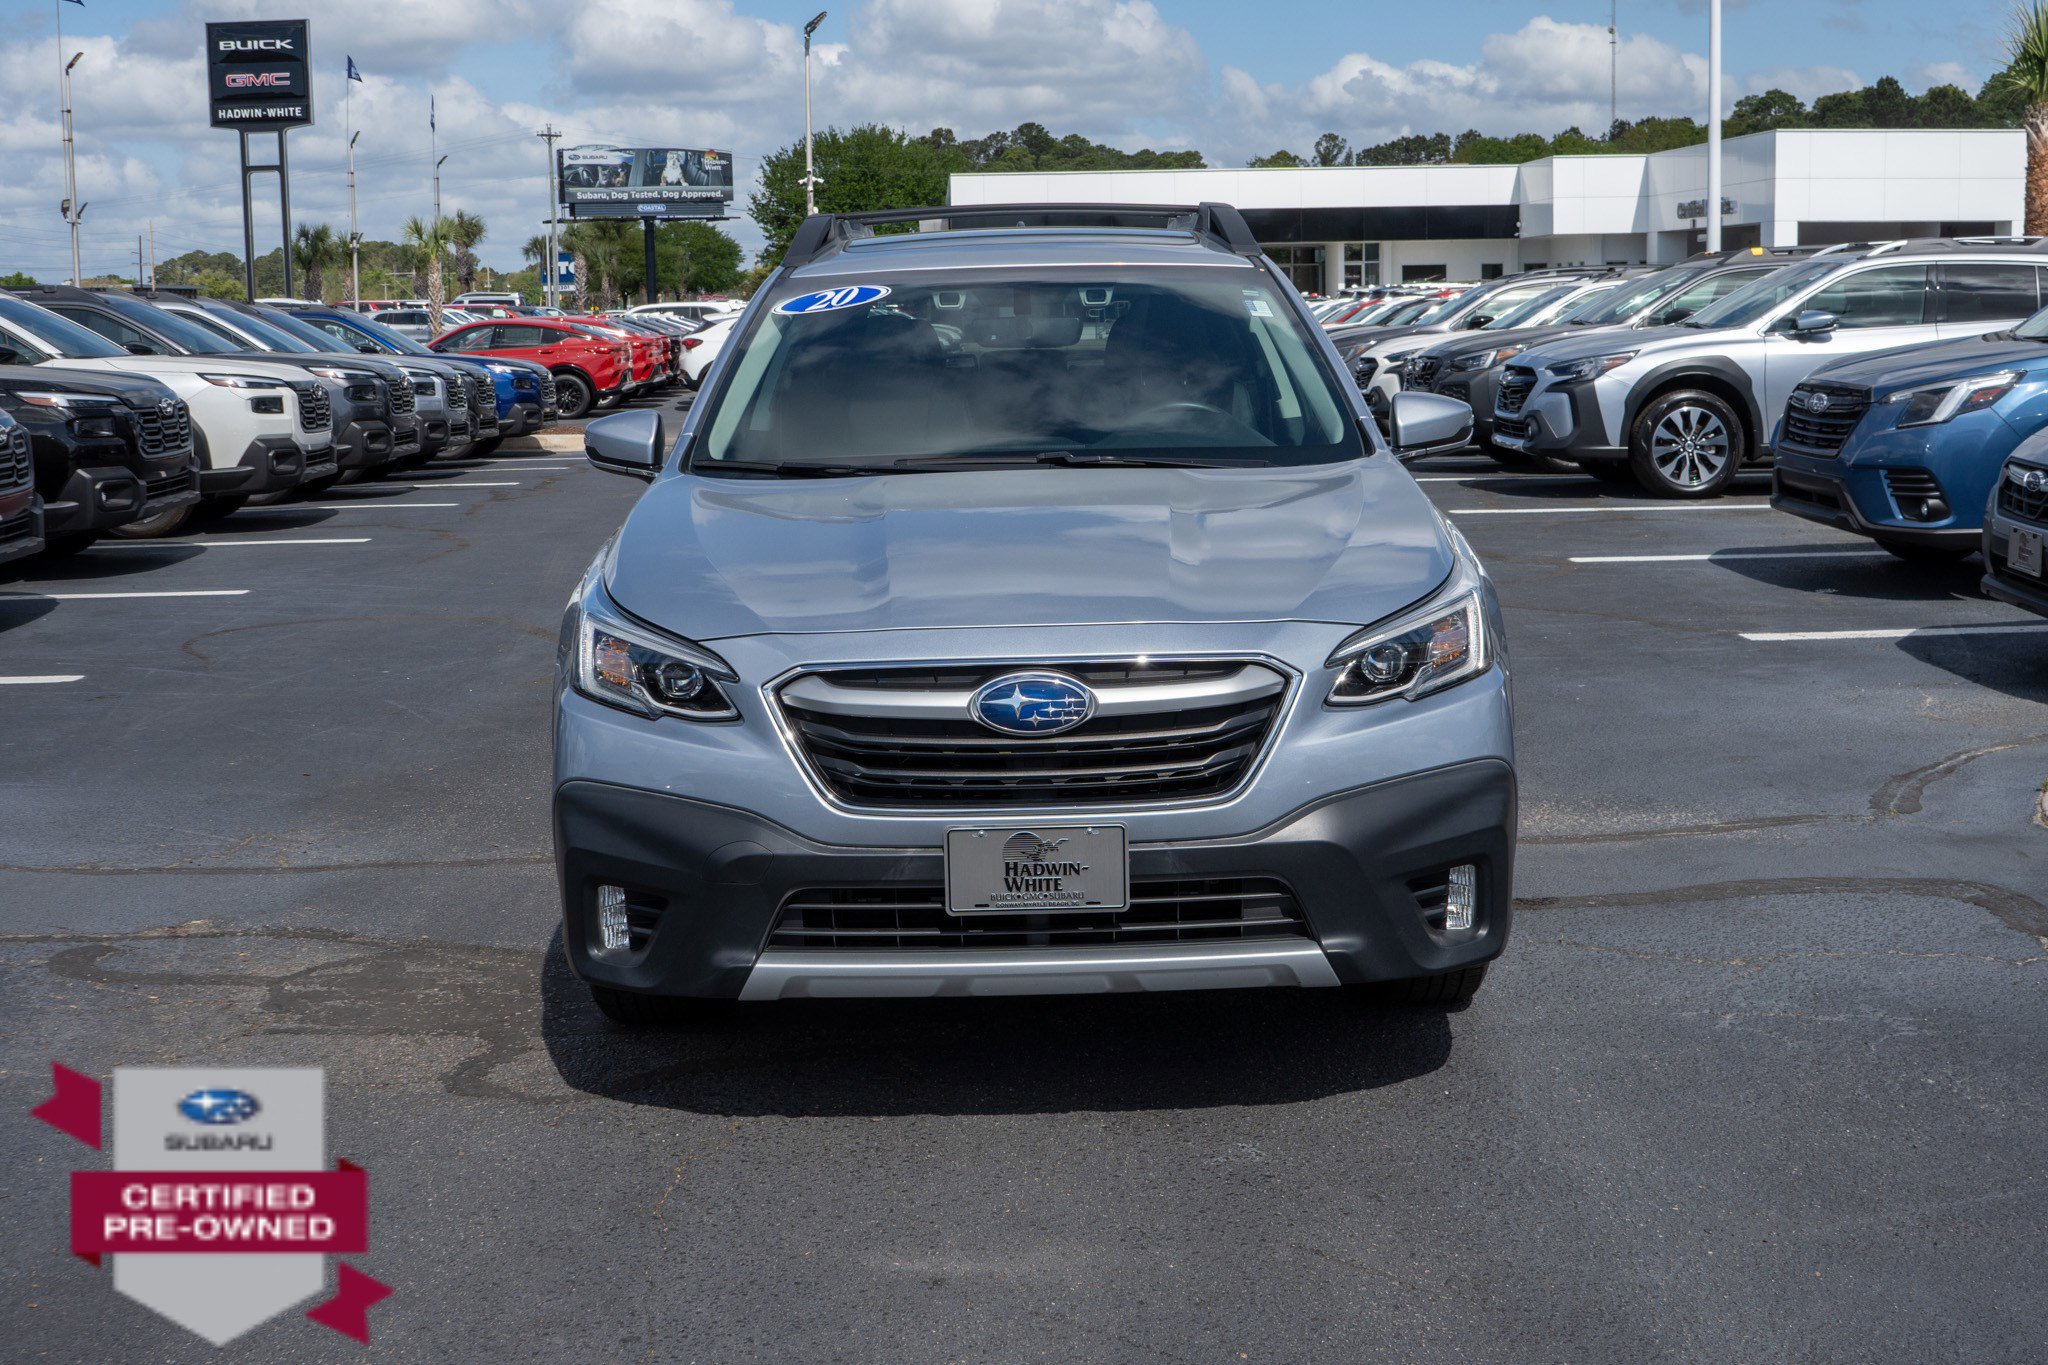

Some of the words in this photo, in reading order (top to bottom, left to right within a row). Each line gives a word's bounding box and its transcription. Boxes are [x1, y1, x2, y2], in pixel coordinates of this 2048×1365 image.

[219, 39, 294, 51] BUICK
[226, 72, 290, 88] GMC
[218, 107, 302, 119] HADWIN-WHITE
[576, 191, 609, 200] Subaru,
[611, 191, 628, 200] Dog
[630, 190, 661, 199] Tested.
[662, 190, 680, 199] Dog
[681, 189, 724, 199] Approved.
[804, 287, 859, 311] 20
[1005, 861, 1090, 876] HADWIN-
[1004, 877, 1063, 892] WHITE
